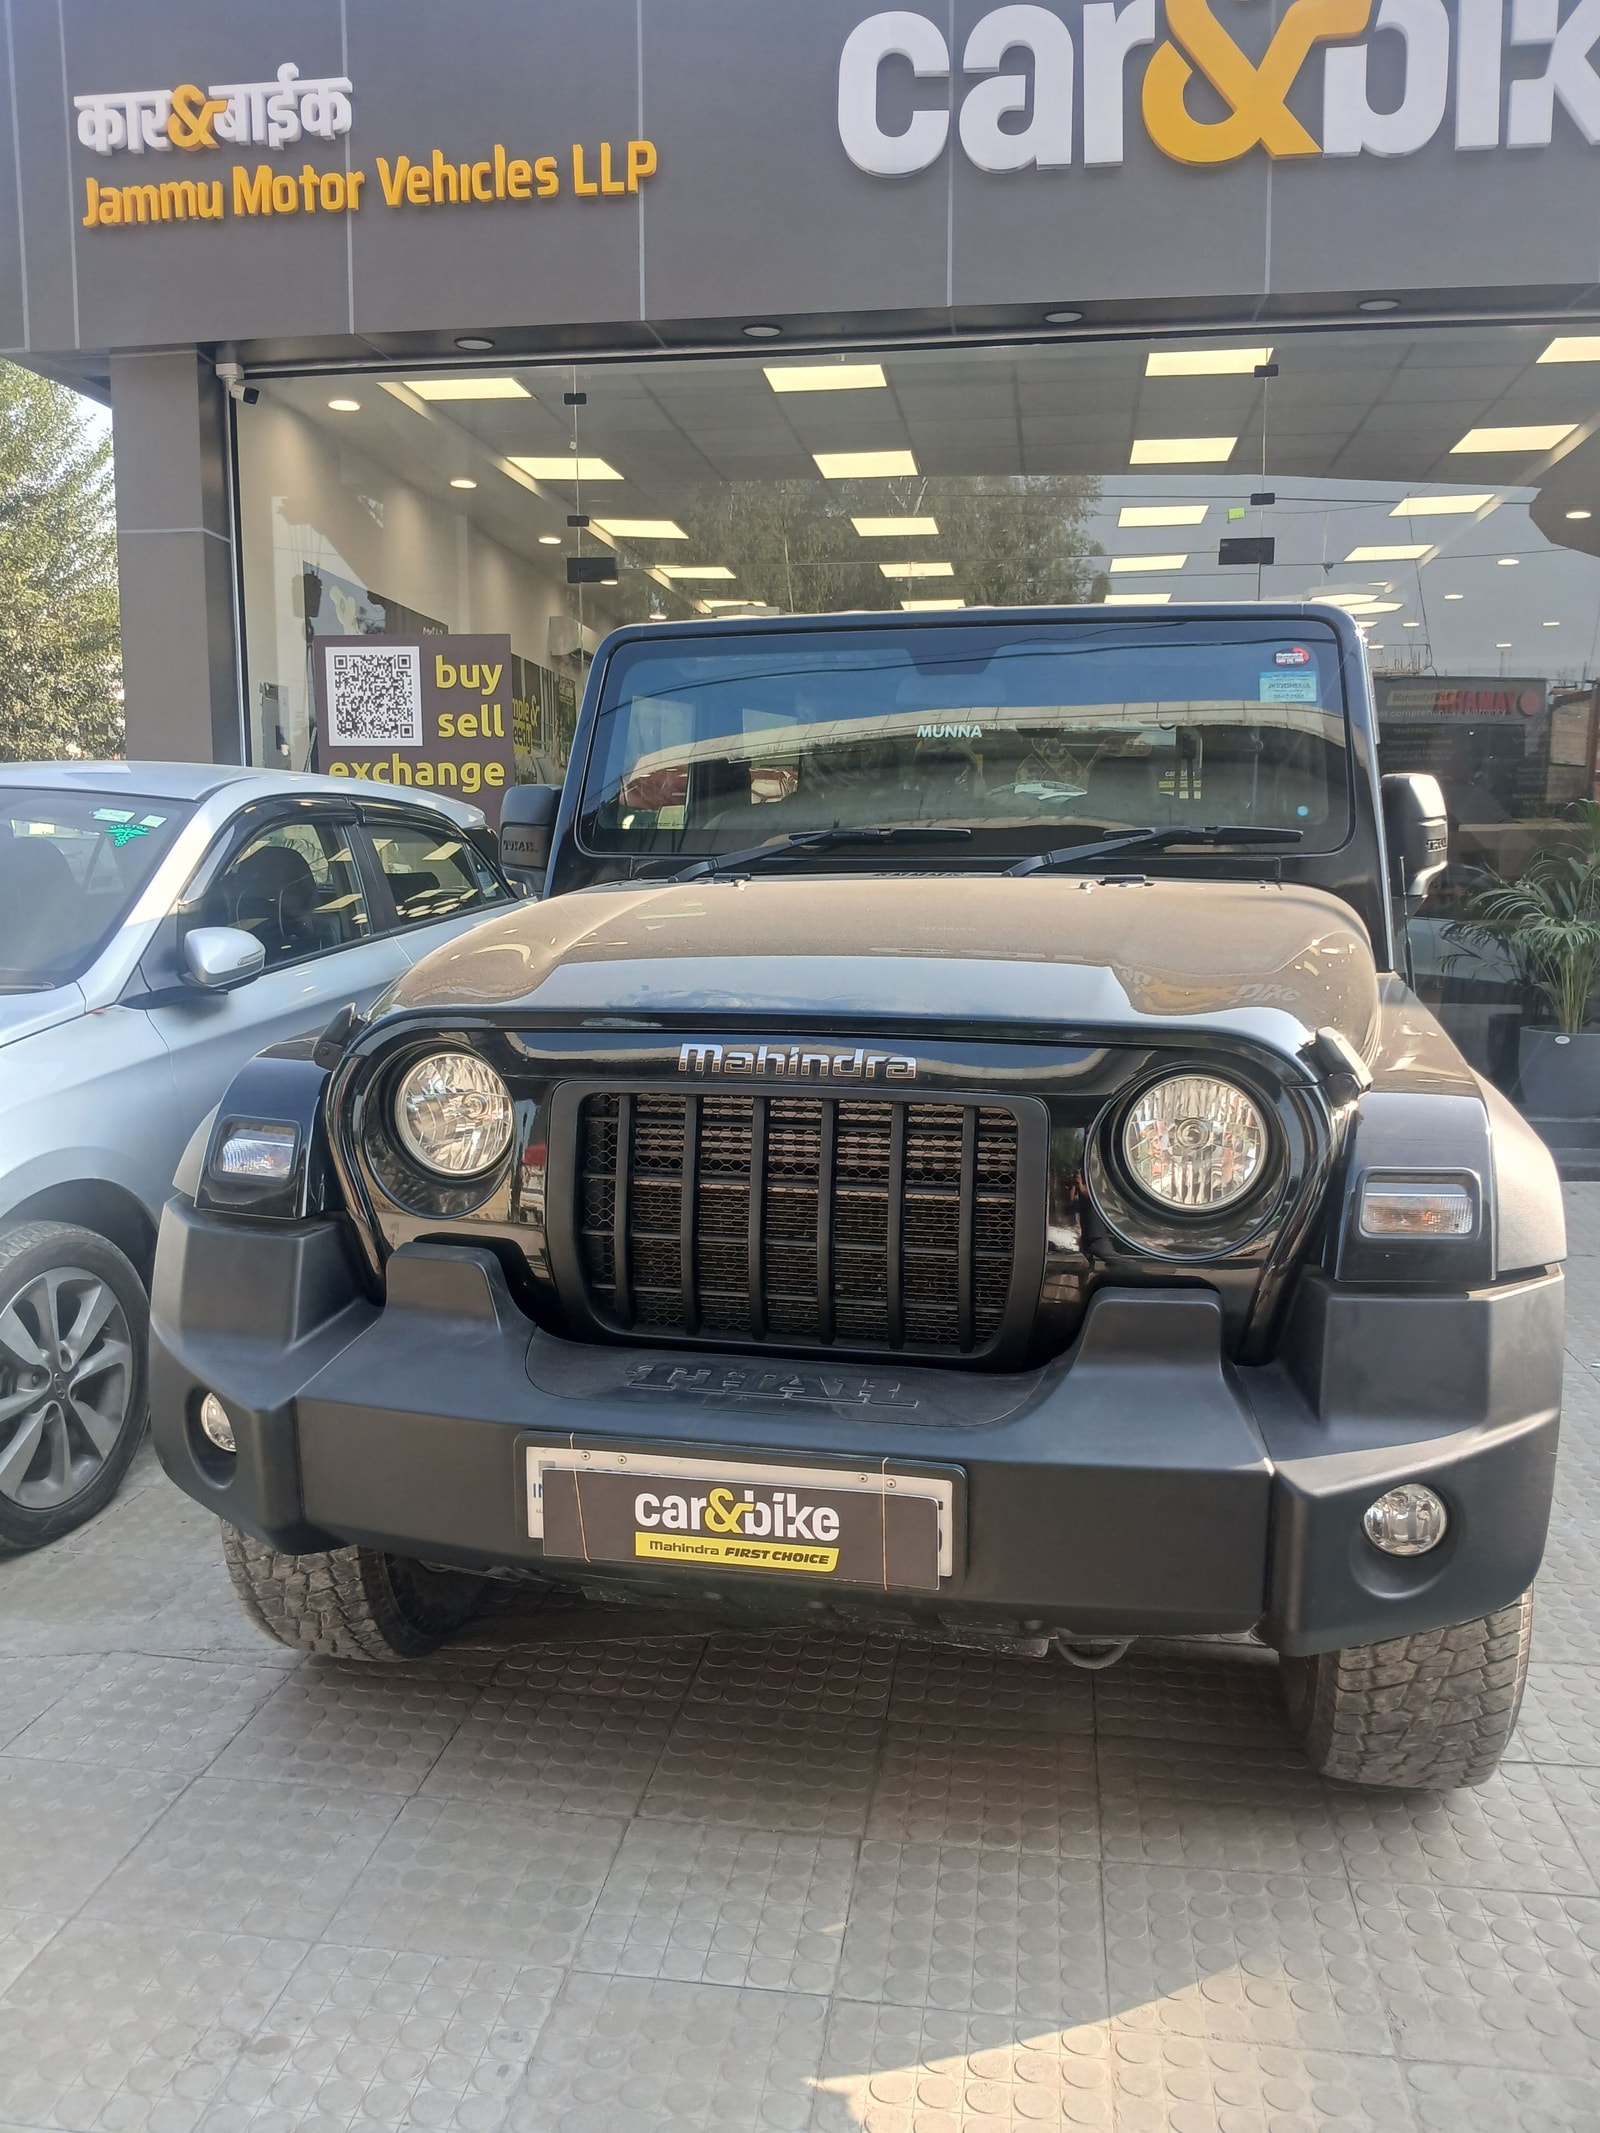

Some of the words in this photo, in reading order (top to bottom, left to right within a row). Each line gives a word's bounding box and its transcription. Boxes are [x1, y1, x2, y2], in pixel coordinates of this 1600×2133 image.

[82, 176, 224, 228] Jammu
[231, 164, 365, 217] Motor
[376, 144, 559, 208] Vehicles
[571, 140, 657, 197] LLP
[435, 655, 503, 696] buy
[438, 704, 505, 738] sell
[916, 724, 983, 738] MUNNA
[513, 726, 532, 755] eedy
[328, 753, 506, 793] exchange
[110, 823, 149, 832] DOCTOR
[677, 1043, 918, 1080] Mahindra
[634, 1487, 840, 1542] car&bike
[649, 1540, 720, 1557] Mahindra
[724, 1547, 770, 1561] FIRST
[771, 1550, 830, 1565] CHOICE
